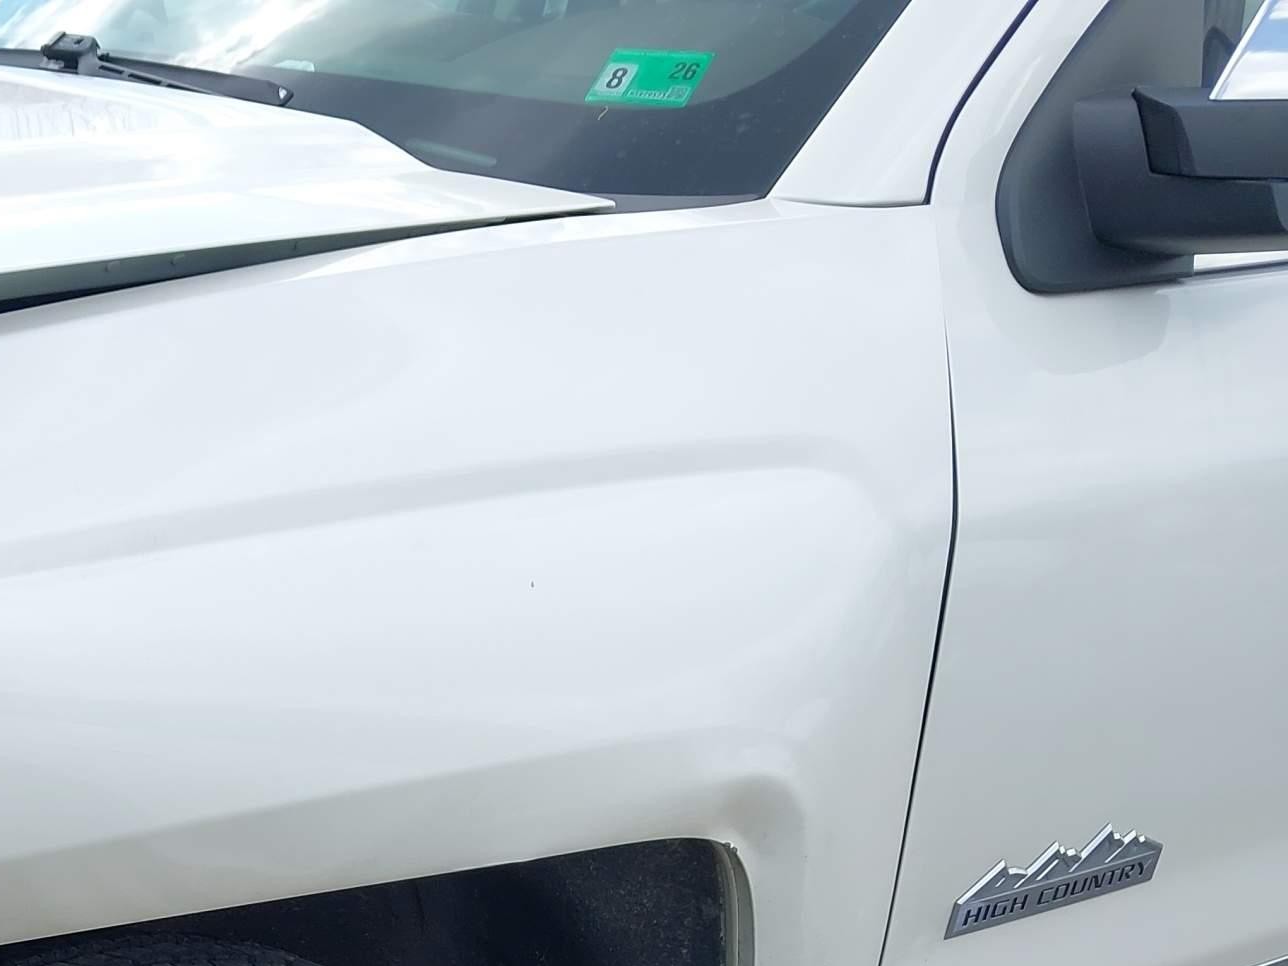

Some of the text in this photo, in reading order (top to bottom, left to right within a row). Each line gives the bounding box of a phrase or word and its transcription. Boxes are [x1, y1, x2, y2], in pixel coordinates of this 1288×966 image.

[605, 67, 629, 89] 8
[668, 62, 700, 81] 26
[962, 860, 1152, 927] HIGH COUNTRY
